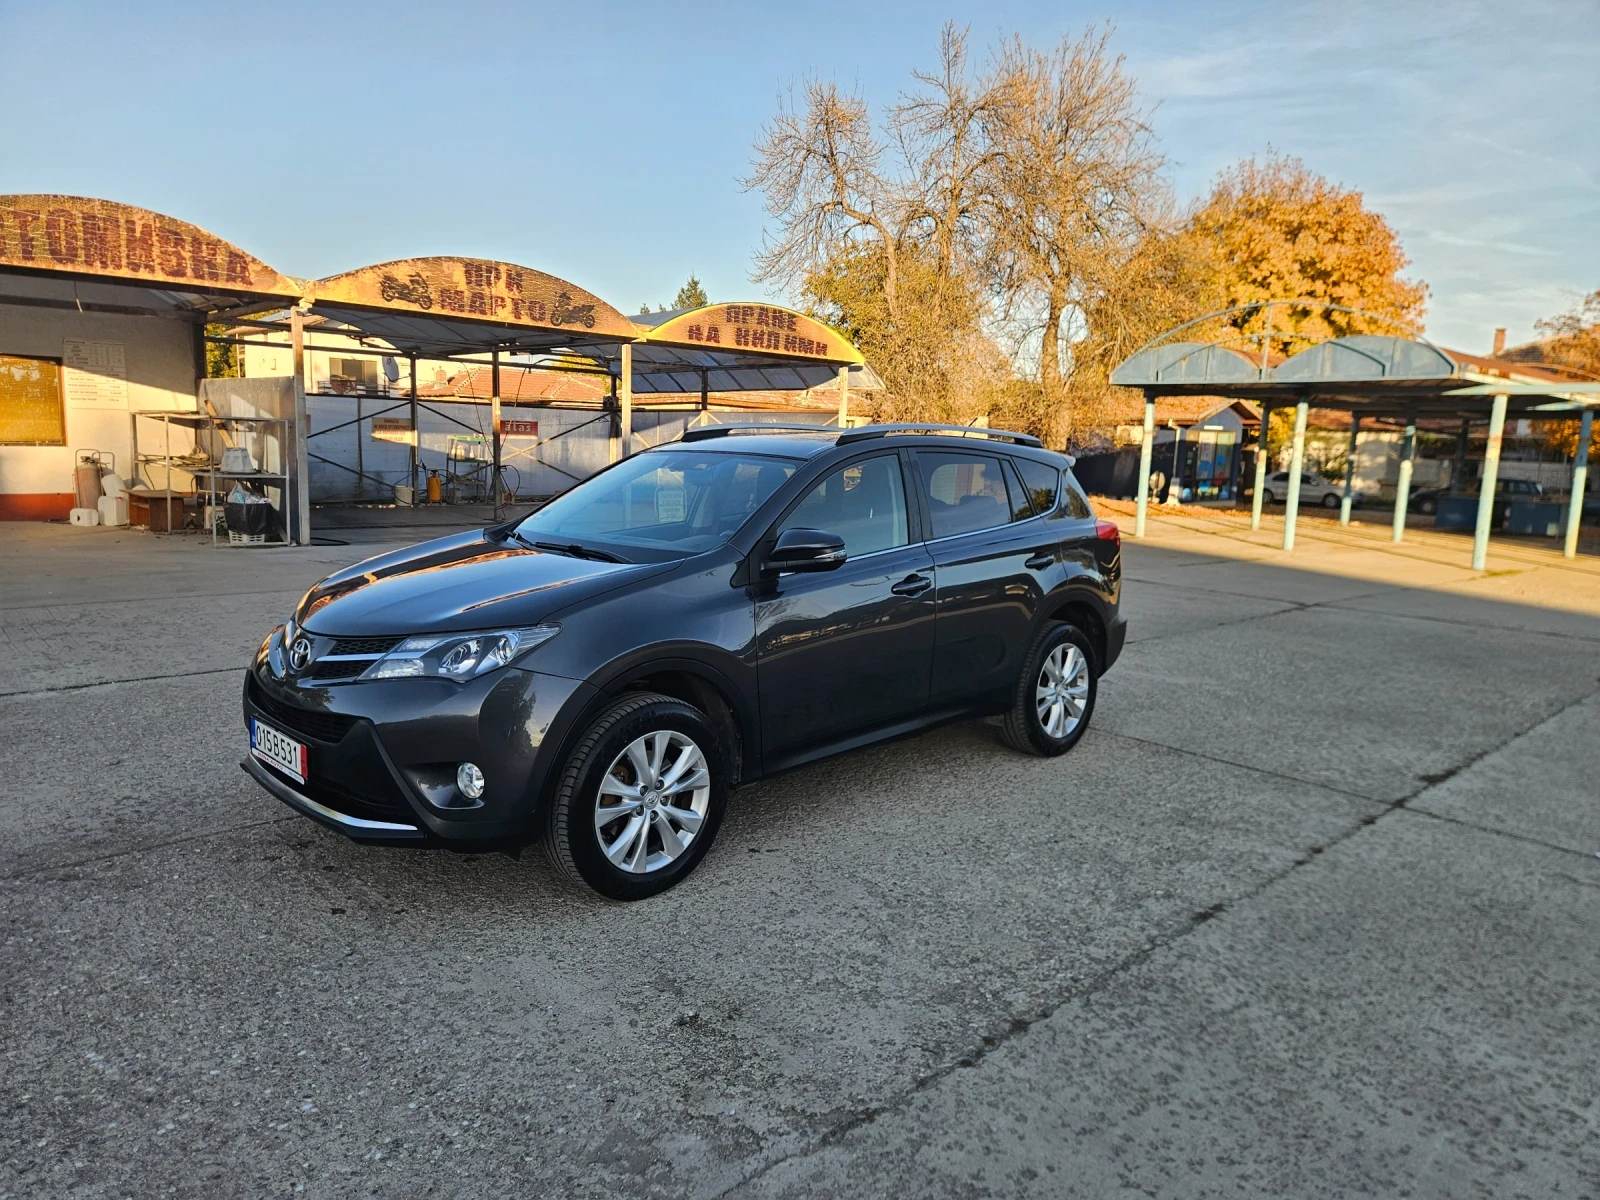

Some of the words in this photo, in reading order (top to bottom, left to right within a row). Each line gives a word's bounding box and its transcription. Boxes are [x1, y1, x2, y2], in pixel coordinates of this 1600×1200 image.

[726, 305, 797, 331] ПРАНЕ
[688, 325, 721, 344] НА
[735, 327, 828, 356] КИЛИМИ
[256, 725, 298, 768] 015B531
